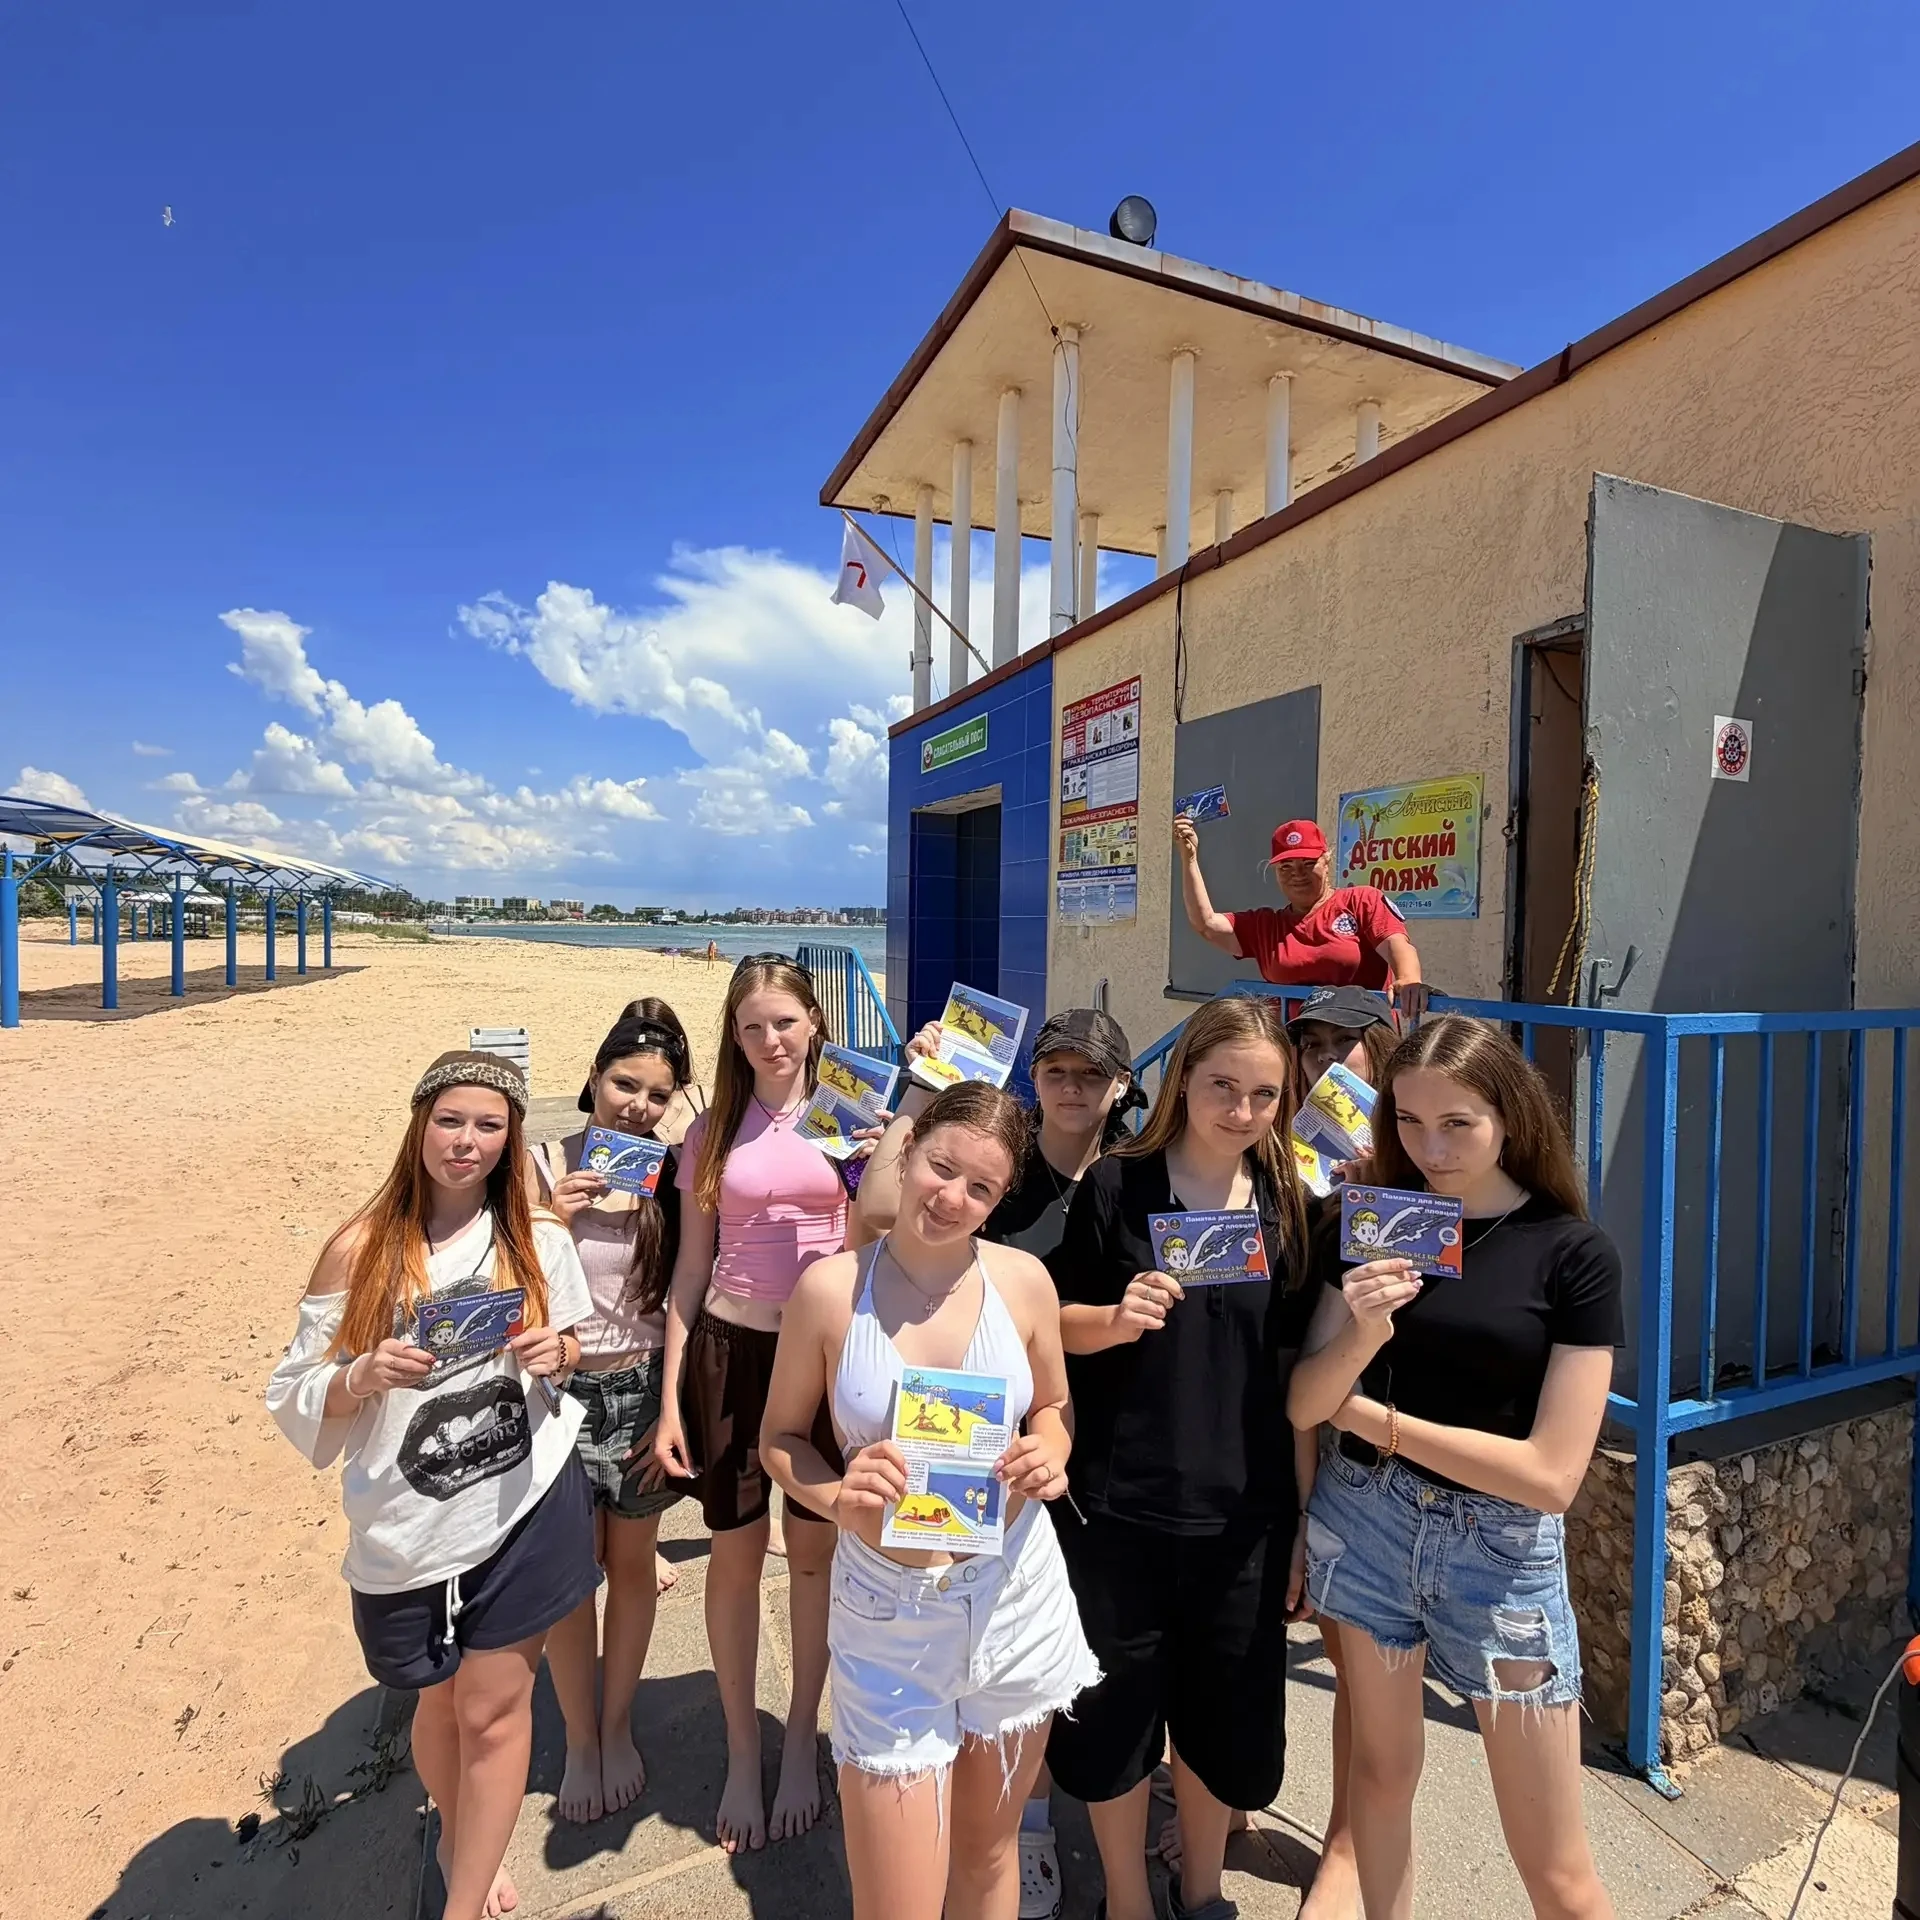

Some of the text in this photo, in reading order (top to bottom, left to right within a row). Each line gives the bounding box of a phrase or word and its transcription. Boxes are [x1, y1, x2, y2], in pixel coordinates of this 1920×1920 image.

[1091, 684, 1130, 705] ТЕРРИТОРИЯ
[1071, 692, 1130, 722] БЕЗОПАСНОСТИ
[934, 728, 984, 758] СПАСАТЕЛЬНЫЙ ПОСТ
[1067, 741, 1137, 765] ГРАЖДАНСКАЯ ОБОРОНА
[1380, 791, 1473, 817] Лучистый
[1063, 814, 1090, 826] ПОЖАРНАЯ
[1090, 806, 1136, 820] БЕЗОПАСНОСТЬ
[1349, 818, 1456, 871] ДЕТСКИЙ
[1370, 863, 1439, 891] ПЛЯЖ
[1382, 1192, 1459, 1208] Памятка для юных
[1185, 1215, 1217, 1223] Памятка
[1424, 1208, 1459, 1217] пловцов
[457, 1298, 487, 1307] Памятка
